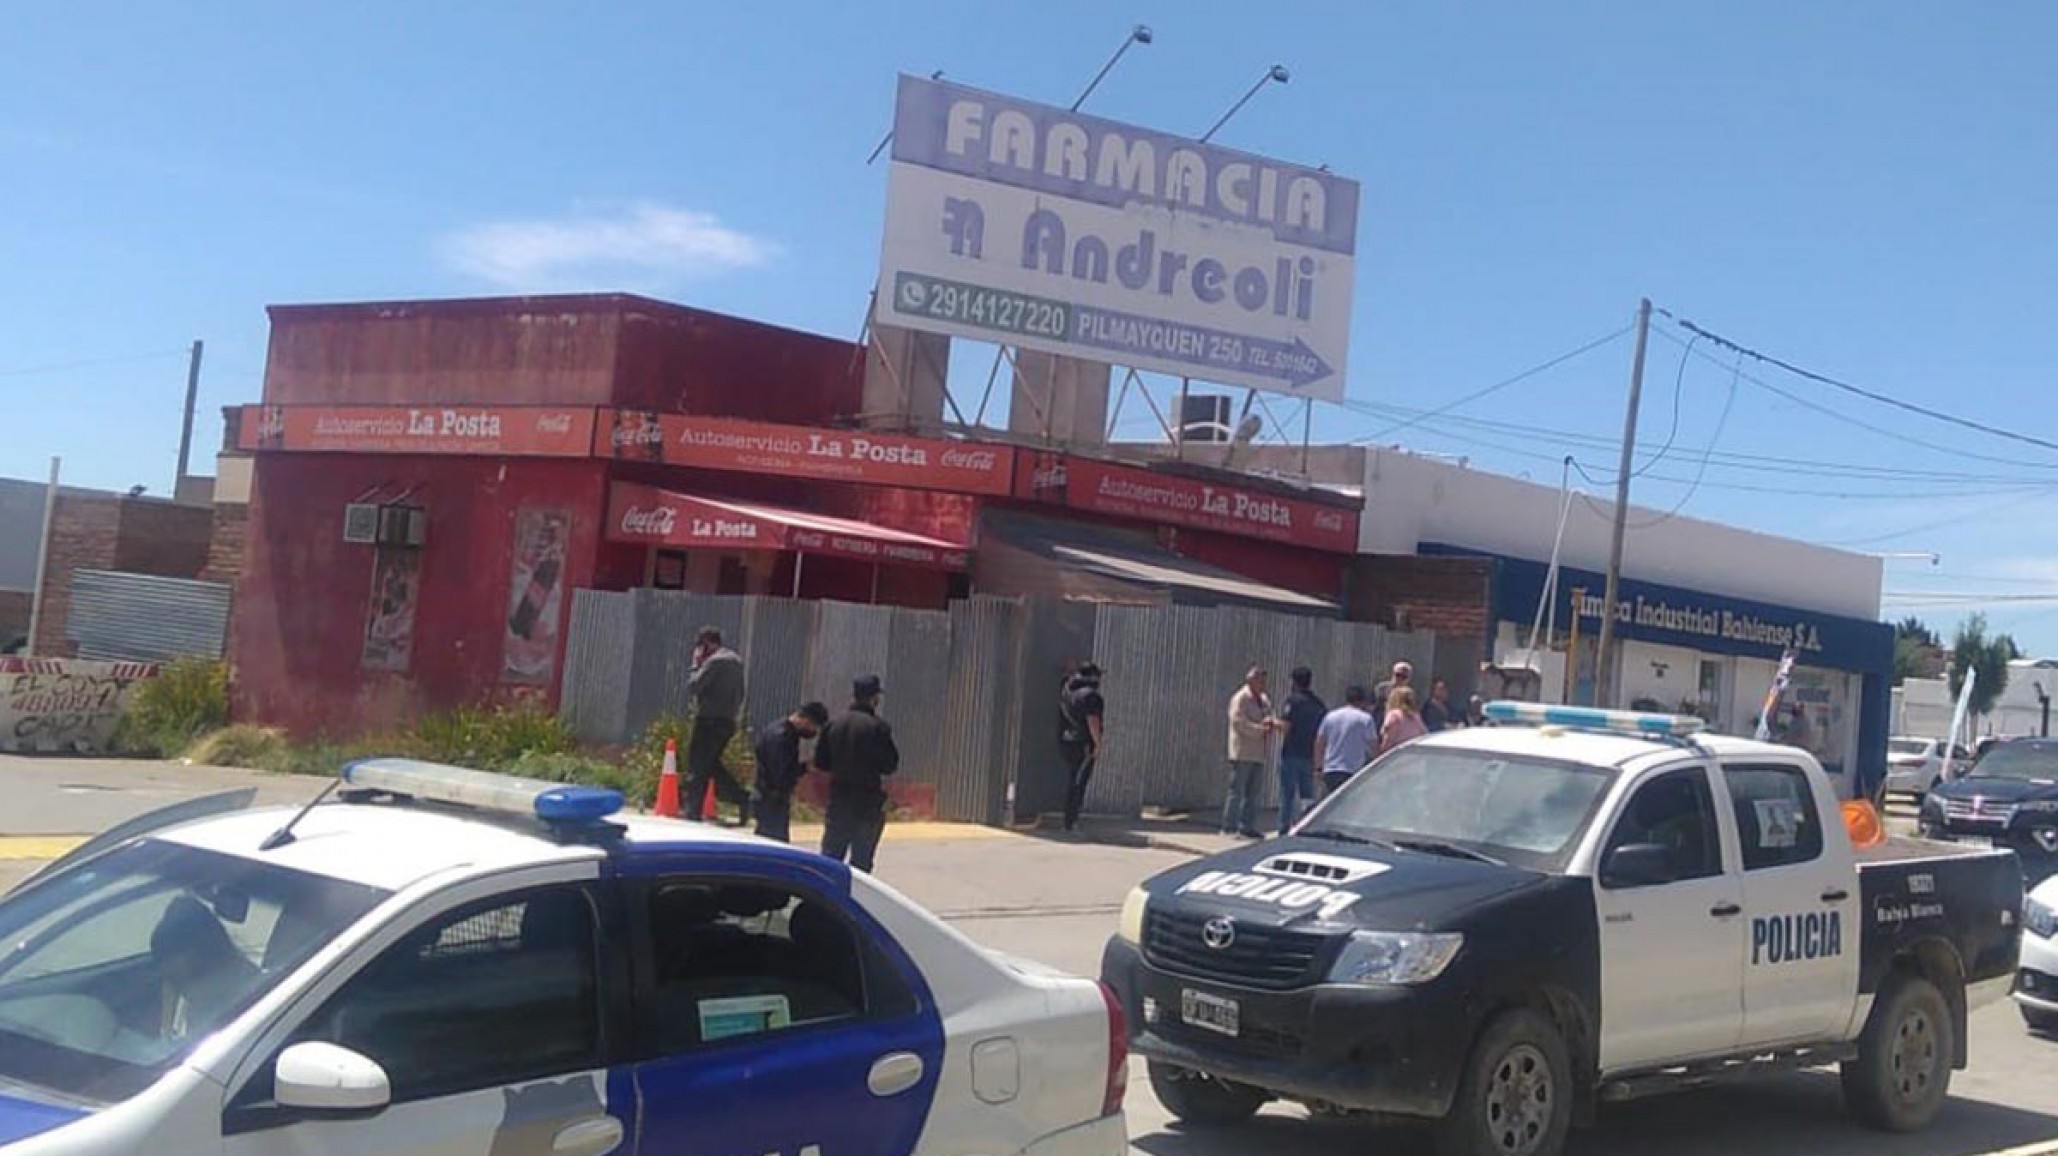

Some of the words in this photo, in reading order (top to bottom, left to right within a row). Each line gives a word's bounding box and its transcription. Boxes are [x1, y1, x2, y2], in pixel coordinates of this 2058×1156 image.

[945, 100, 1326, 232] FARMACIA
[1020, 207, 1314, 322] Andreoli
[930, 284, 1065, 336] 2914127220
[1077, 312, 1202, 357] PILMAYQUEN
[1209, 335, 1243, 363] 250
[407, 409, 434, 435] La
[439, 409, 500, 437] Posta
[679, 427, 801, 455] Autoservicio
[807, 434, 843, 458] La
[849, 438, 928, 467] Posta
[1099, 476, 1198, 509] Autoservicio
[1201, 487, 1229, 515] La
[1234, 493, 1291, 527] Posta
[692, 519, 712, 536] La
[714, 519, 758, 538] Posta
[1635, 594, 1719, 635] Industrial
[1721, 610, 1793, 646] Bahiense
[1752, 911, 1841, 965] POLICIA
